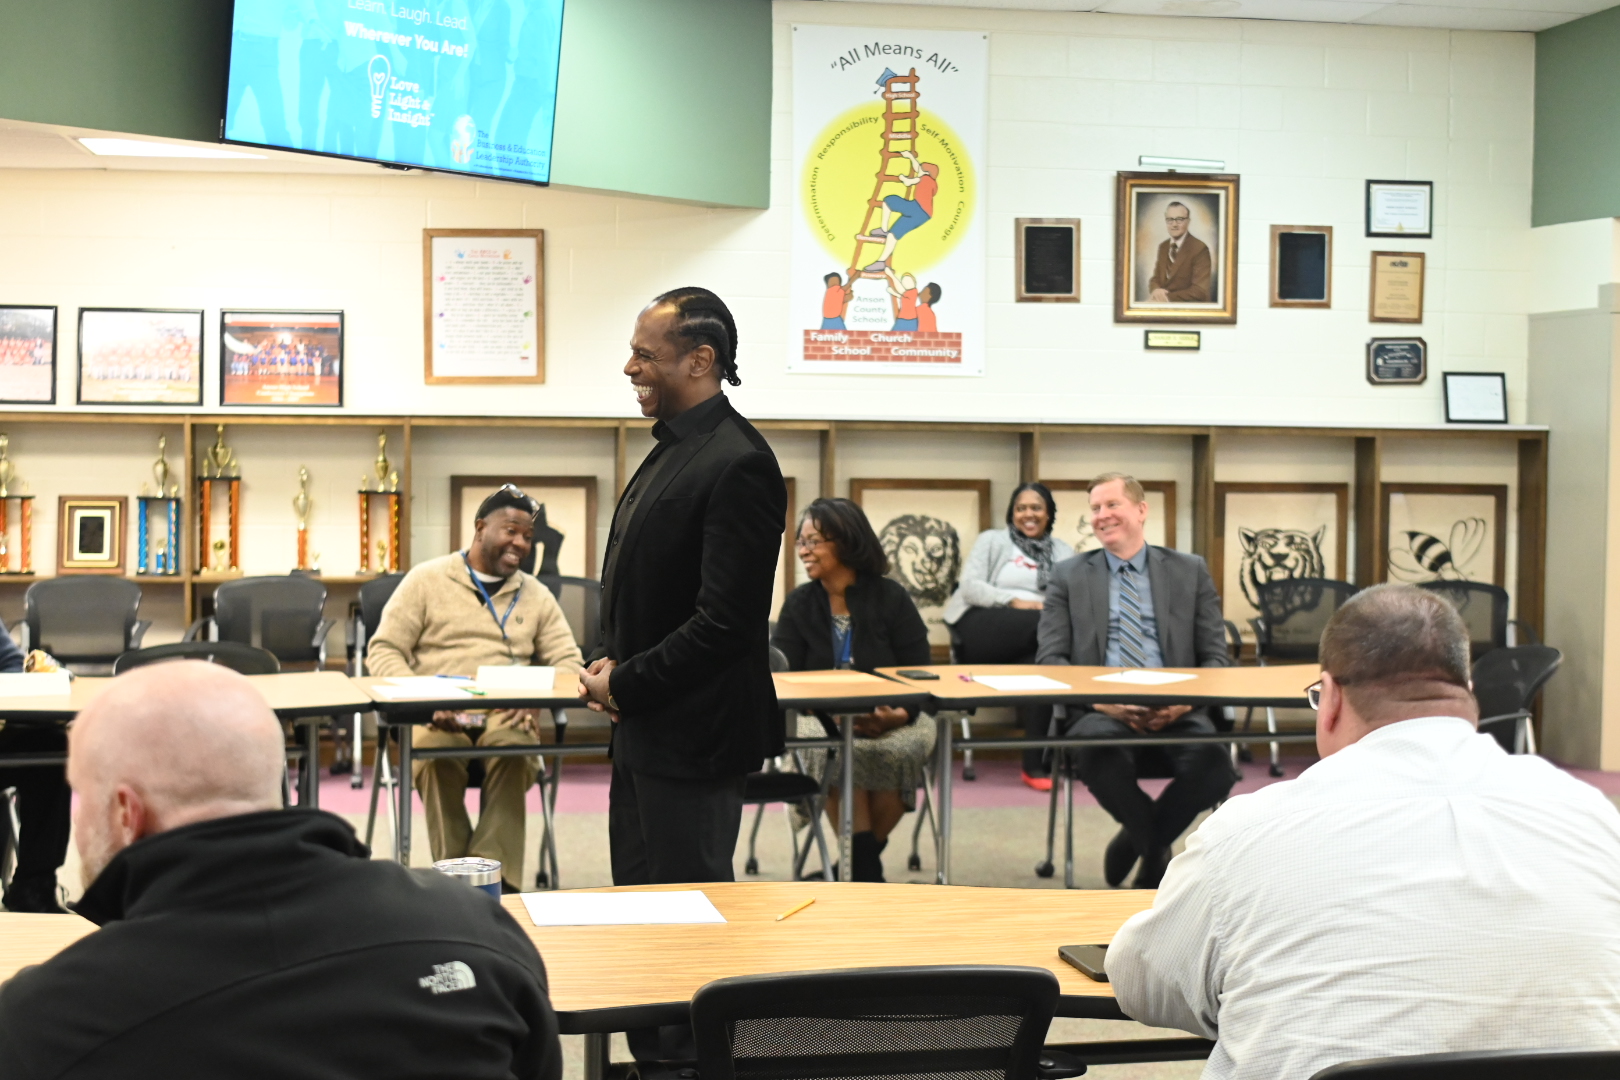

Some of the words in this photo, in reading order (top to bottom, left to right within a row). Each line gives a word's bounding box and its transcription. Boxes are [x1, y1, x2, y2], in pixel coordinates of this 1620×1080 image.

[391, 1, 433, 25] Laugh.
[344, 21, 412, 47] Wherever
[414, 34, 439, 52] You
[441, 40, 468, 57] Are!
[864, 42, 923, 60] Means
[390, 77, 419, 93] Love
[389, 92, 421, 110] Light
[421, 100, 431, 110] &
[477, 130, 489, 139] The
[817, 116, 879, 160] Responsibility
[513, 144, 546, 157] Education
[920, 123, 965, 193] Self-Motivation
[475, 151, 514, 165] Leadership
[515, 157, 546, 170] Authority
[810, 166, 836, 242] Determination
[941, 201, 965, 242] Courage
[856, 296, 885, 304] Anson
[853, 305, 887, 315] County
[852, 315, 888, 324] Schools
[810, 332, 848, 343] Family
[870, 333, 912, 343] Church
[832, 346, 871, 356] School
[891, 347, 959, 359] Community
[432, 962, 455, 974] THE
[418, 970, 456, 988] NORTH
[432, 980, 459, 995] FACE
